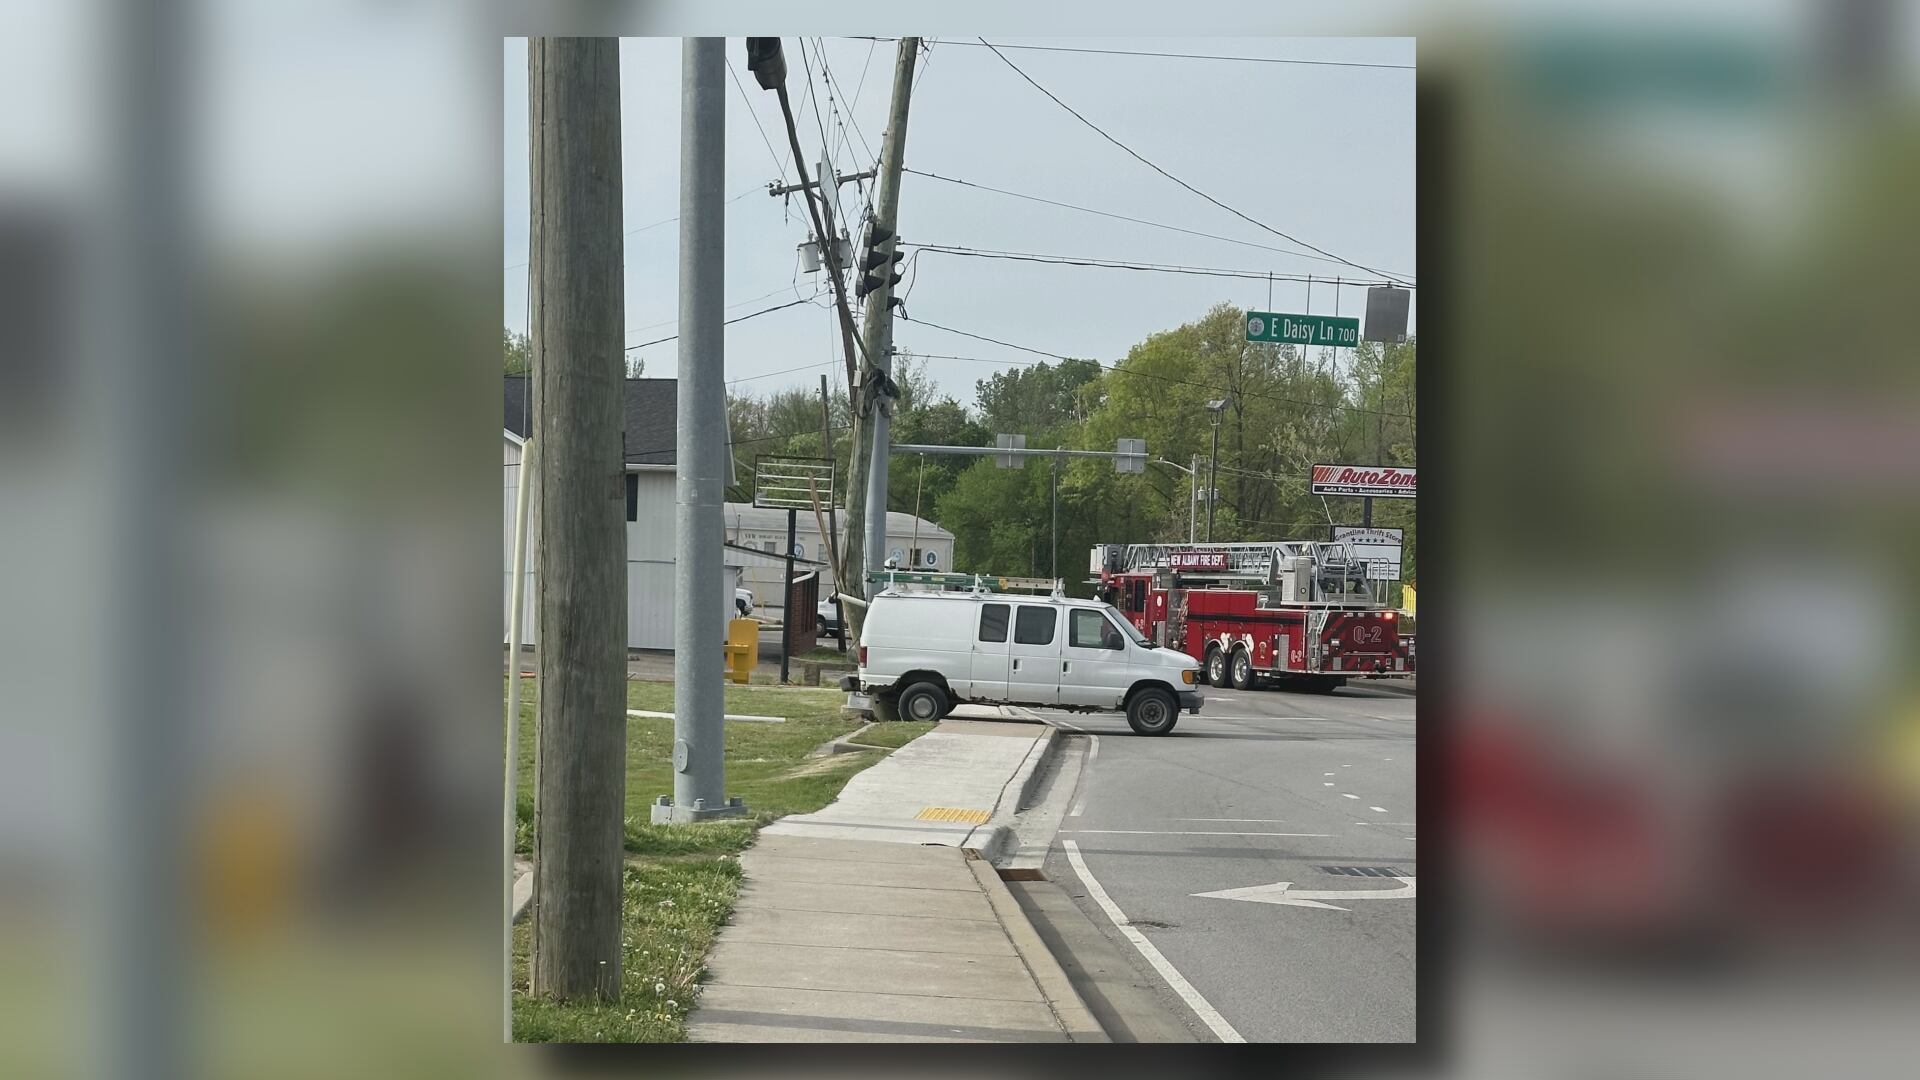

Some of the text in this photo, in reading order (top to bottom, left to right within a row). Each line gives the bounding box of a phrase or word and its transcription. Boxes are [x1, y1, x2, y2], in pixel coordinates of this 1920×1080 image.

[1271, 317, 1356, 343] E Daisy Ln 700
[1335, 528, 1402, 544] Grantline Thrift Store
[1170, 554, 1181, 566] NEW
[1182, 554, 1200, 566] ALBANY
[1200, 554, 1211, 566] FIRE
[1353, 625, 1382, 644] Q-2
[1290, 649, 1303, 663] Q-2
